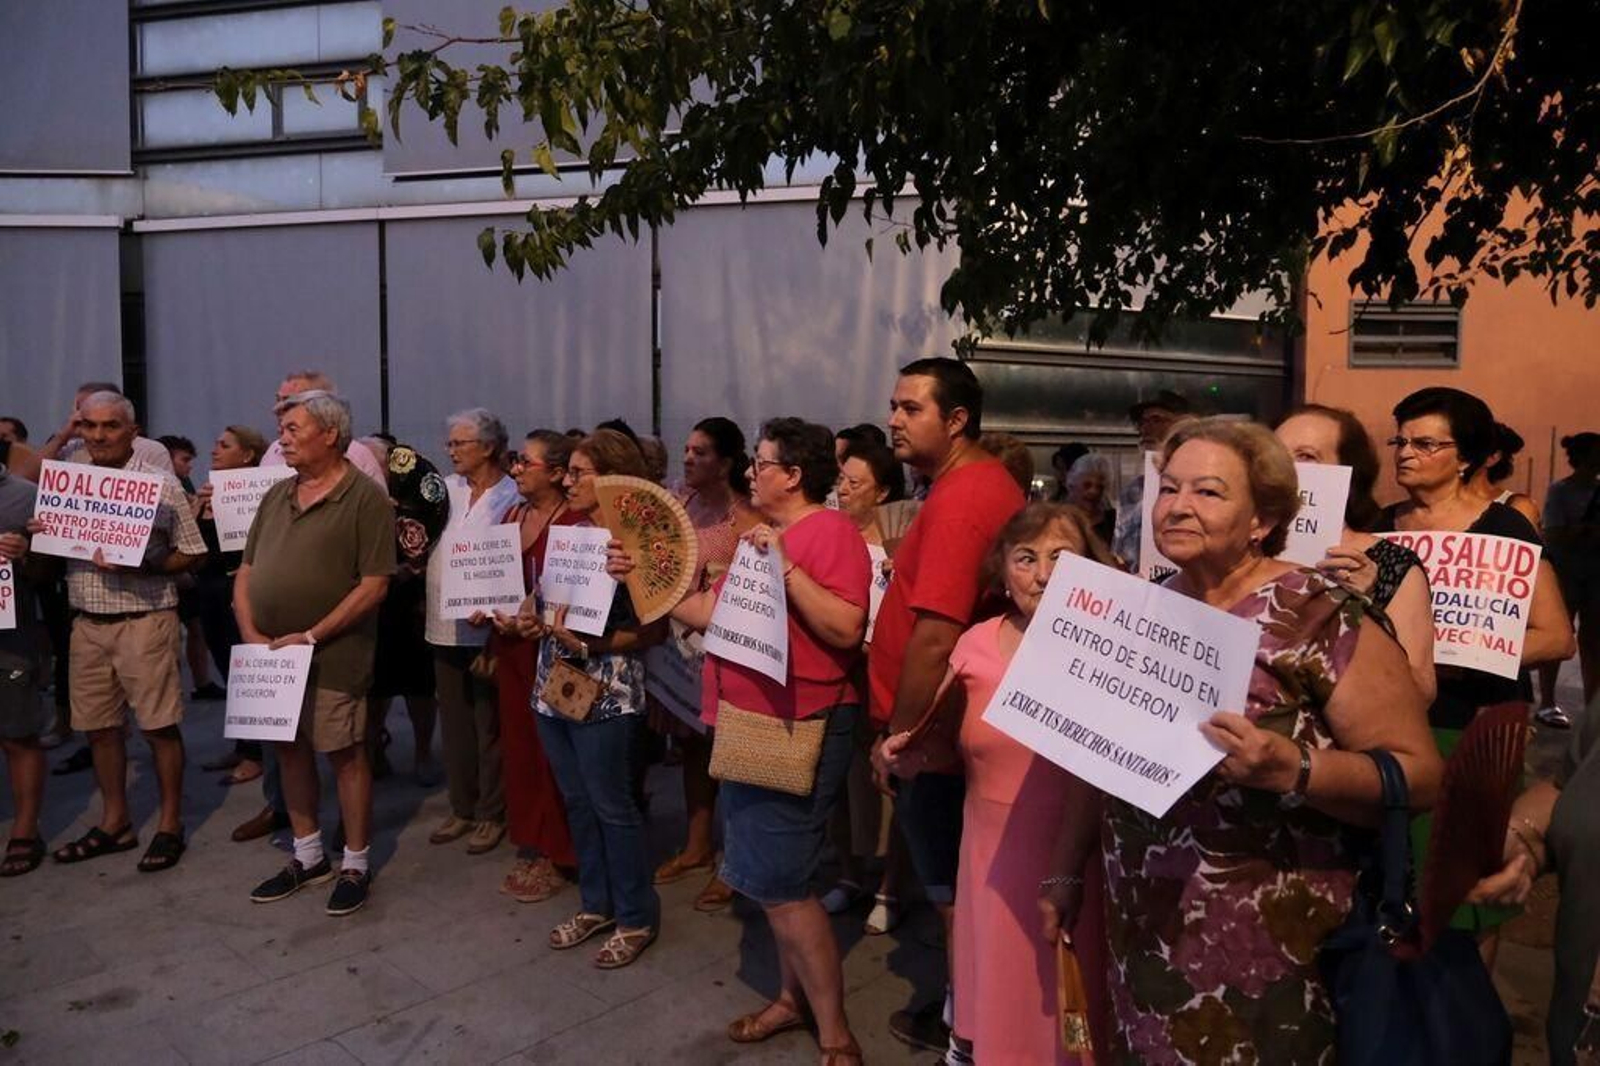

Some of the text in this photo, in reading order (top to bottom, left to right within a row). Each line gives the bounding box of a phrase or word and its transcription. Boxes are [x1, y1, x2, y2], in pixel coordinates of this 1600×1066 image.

[42, 468, 159, 505] NO AL CIERRE
[1300, 490, 1317, 507] EL
[40, 494, 154, 520] NO AL TRASLADO
[38, 510, 150, 537] CENTRO DE SALUD
[43, 524, 142, 548] EN EL HIGUERON
[1295, 517, 1318, 535] EN
[739, 556, 751, 569] AL
[1438, 535, 1535, 578] SALUD
[743, 578, 756, 592] DE
[1424, 566, 1530, 599] ARRIO
[1066, 587, 1221, 671] ¡No! AL CIERRE DEL
[1434, 609, 1495, 631] ECUTA
[1052, 617, 1220, 708] CENTRO DE SALUD EN
[1068, 657, 1180, 723] EL HIGUERON
[1039, 707, 1062, 732] TUS
[1058, 718, 1116, 759] DERECHOS
